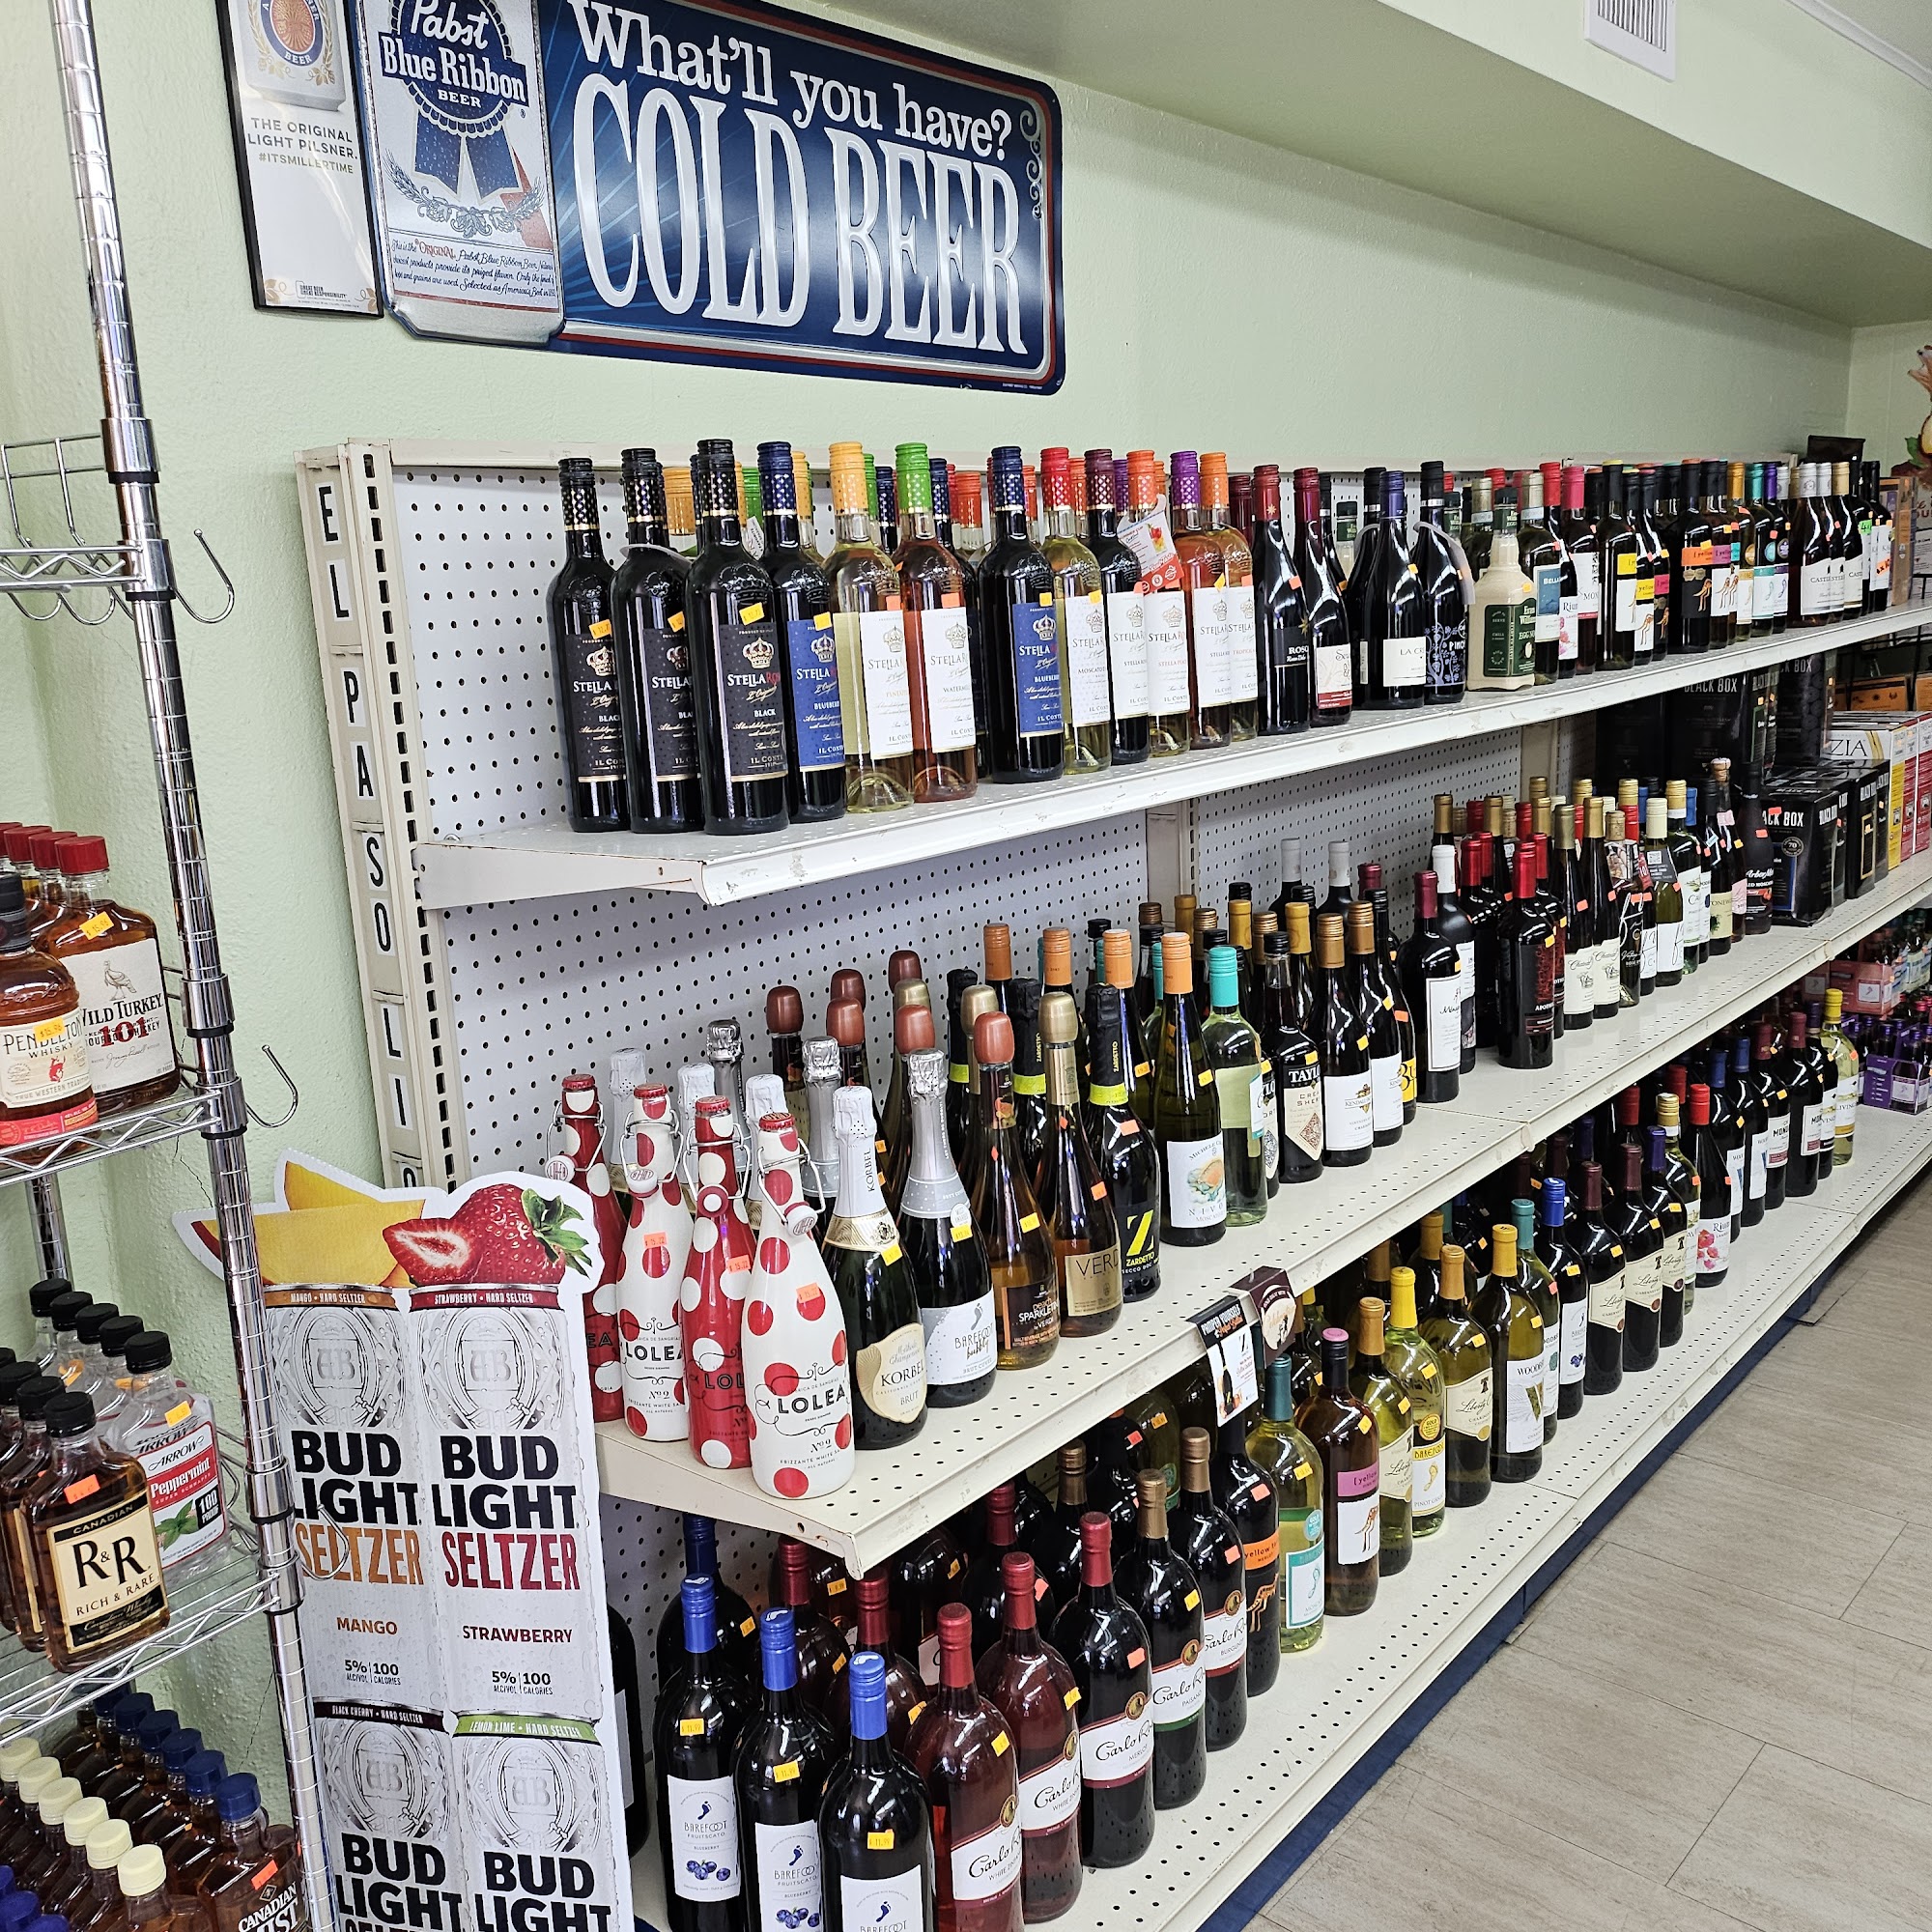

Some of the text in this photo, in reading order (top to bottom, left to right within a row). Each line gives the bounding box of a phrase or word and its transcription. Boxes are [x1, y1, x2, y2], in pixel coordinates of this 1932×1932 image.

[412, 0, 490, 49] Pabst
[284, 51, 312, 65] BEER
[380, 32, 527, 102] Blue Ribbon
[567, 0, 1012, 160] What'll you have?
[437, 89, 482, 109] BEER
[251, 117, 354, 143] THE ORIGINAL
[247, 133, 358, 160] LIGHT PILSNER.
[259, 153, 354, 174] #ITSMILLERTIME
[574, 73, 1028, 355] COLD BEER
[418, 242, 456, 259] ORIGINAL
[435, 263, 461, 274] provide
[459, 278, 492, 291] Selected
[1794, 659, 1812, 673] BOX
[1718, 678, 1737, 693] BOX
[1831, 739, 1867, 756] ZIA
[1783, 811, 1804, 828] BOX
[114, 993, 164, 1018] TURKEY
[99, 1017, 150, 1047] 101
[29, 1042, 74, 1059] WHISKY
[14, 1084, 67, 1100] TRUE WESTERN
[863, 1147, 876, 1193] KORBEL
[1126, 1209, 1154, 1256] Z
[1075, 1249, 1120, 1277] VERD
[1125, 1252, 1155, 1267] ZARDETTO
[338, 1293, 366, 1304] SELTZER
[434, 1292, 533, 1304] STRAWBERRY HARD SELTZER
[585, 1332, 613, 1348] EA
[626, 1345, 682, 1362] LOLE
[704, 1373, 744, 1390] LOL
[881, 1359, 925, 1387] KORBEL
[778, 1383, 846, 1414] LOLEA
[900, 1391, 919, 1406] BRUT
[153, 1437, 201, 1469] ARROW
[291, 1431, 402, 1478] BUD
[440, 1435, 559, 1481] BUD
[151, 1457, 211, 1498] Peppermint
[155, 1492, 179, 1505] SUPER
[199, 1490, 218, 1514] 100
[432, 1483, 578, 1530] LIGHT
[1414, 1498, 1432, 1508] PINOT
[72, 1504, 134, 1535] CANADIAN
[202, 1506, 219, 1524] PROOF
[296, 1523, 424, 1585] SELTZER
[441, 1531, 582, 1591] SELTZER
[76, 1573, 155, 1617] RICH & RARE
[336, 1616, 398, 1635] MANGO
[462, 1625, 573, 1644] STRAWBERRY
[344, 1660, 399, 1676] 5% 100
[491, 1670, 552, 1686] 5% 100
[373, 1675, 401, 1686] CALORIES
[523, 1685, 554, 1695] CALORIES
[1152, 1676, 1192, 1705] Carlo
[351, 1706, 374, 1718] CHERRY
[399, 1712, 424, 1724] SELTZER
[469, 1720, 582, 1738] LEMON LIME HARD SELTZER
[1095, 1735, 1138, 1761] Carlo
[1128, 1744, 1149, 1762] MERLOT
[1034, 1776, 1073, 1809] Carlo
[684, 1820, 727, 1833] BAREFOOT
[341, 1832, 446, 1886] BUD
[968, 1846, 1010, 1879] Carlo
[484, 1851, 595, 1899] BUD
[778, 1875, 818, 1887] FRUITSCATO
[988, 1868, 1008, 1882] WHITE
[335, 1874, 465, 1932] LIGHT
[784, 1889, 812, 1898] BLUEBERRY
[238, 1882, 298, 1932] CANADIAN
[474, 1893, 611, 1932] LIGHT
